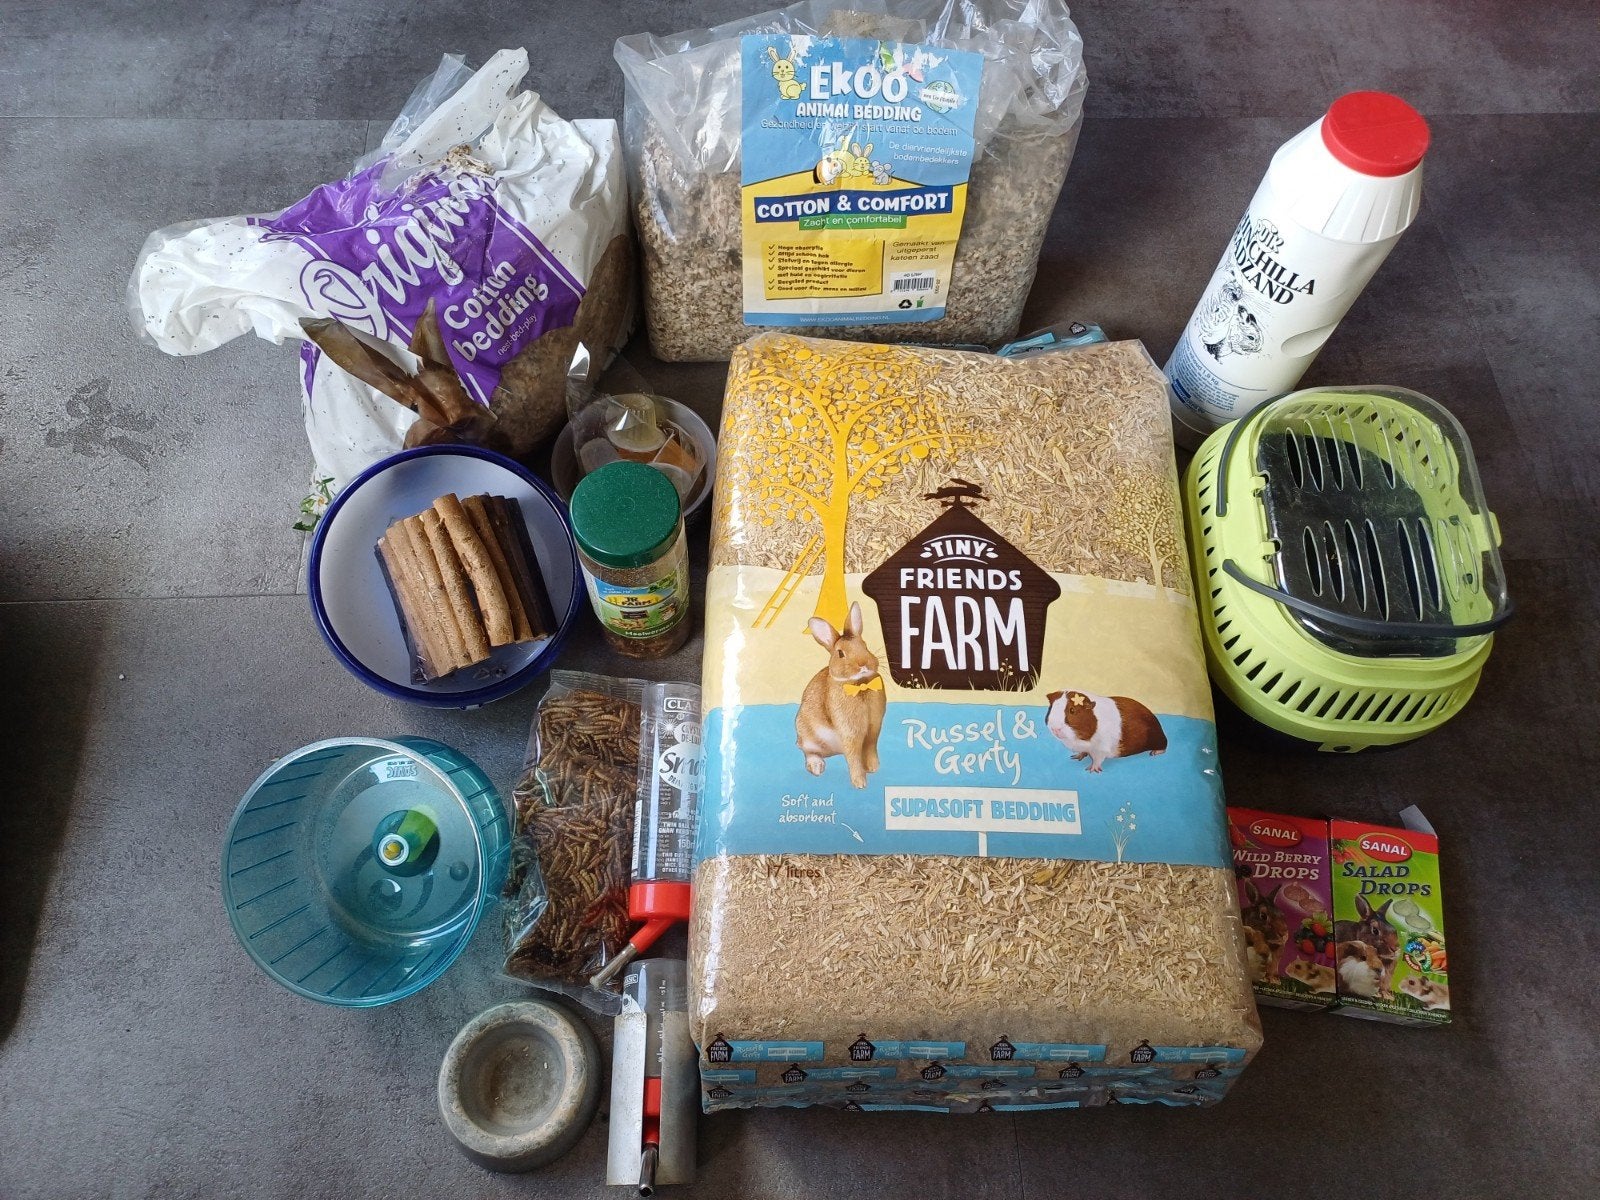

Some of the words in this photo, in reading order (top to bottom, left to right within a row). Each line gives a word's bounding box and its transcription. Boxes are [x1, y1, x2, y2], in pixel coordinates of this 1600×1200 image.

[853, 104, 922, 122] BEDDING
[927, 126, 958, 136] bodem
[757, 198, 830, 218] COTTON
[836, 195, 852, 212] &
[858, 193, 949, 212] COMFORT
[804, 216, 830, 228] Zacht
[846, 216, 902, 225] comfortabel
[444, 261, 516, 330] Cotton
[452, 274, 548, 362] bedding
[930, 540, 988, 558] TINY
[900, 568, 1022, 590] FRIENDS
[901, 596, 1029, 672] FARM
[667, 700, 699, 710] CLAS
[902, 709, 1006, 750] Russel
[1012, 710, 1038, 740] &
[934, 740, 1022, 786] Gerty
[782, 794, 809, 807] Soft
[812, 793, 834, 807] and
[779, 810, 837, 824] absorbent
[890, 798, 984, 819] SUPASOFT
[991, 800, 1076, 822] BEDDING
[1253, 825, 1298, 840] SANAL
[1362, 840, 1407, 856] SANAL
[1274, 851, 1322, 865] BERRY
[767, 864, 782, 878] 17
[787, 865, 822, 878] litres
[1253, 864, 1319, 880] DROPS
[1342, 862, 1410, 878] SALAD
[1359, 880, 1431, 896] DROPS
[710, 1051, 728, 1061] FARM
[853, 1050, 871, 1059] FARM
[993, 1050, 1011, 1059] FARM
